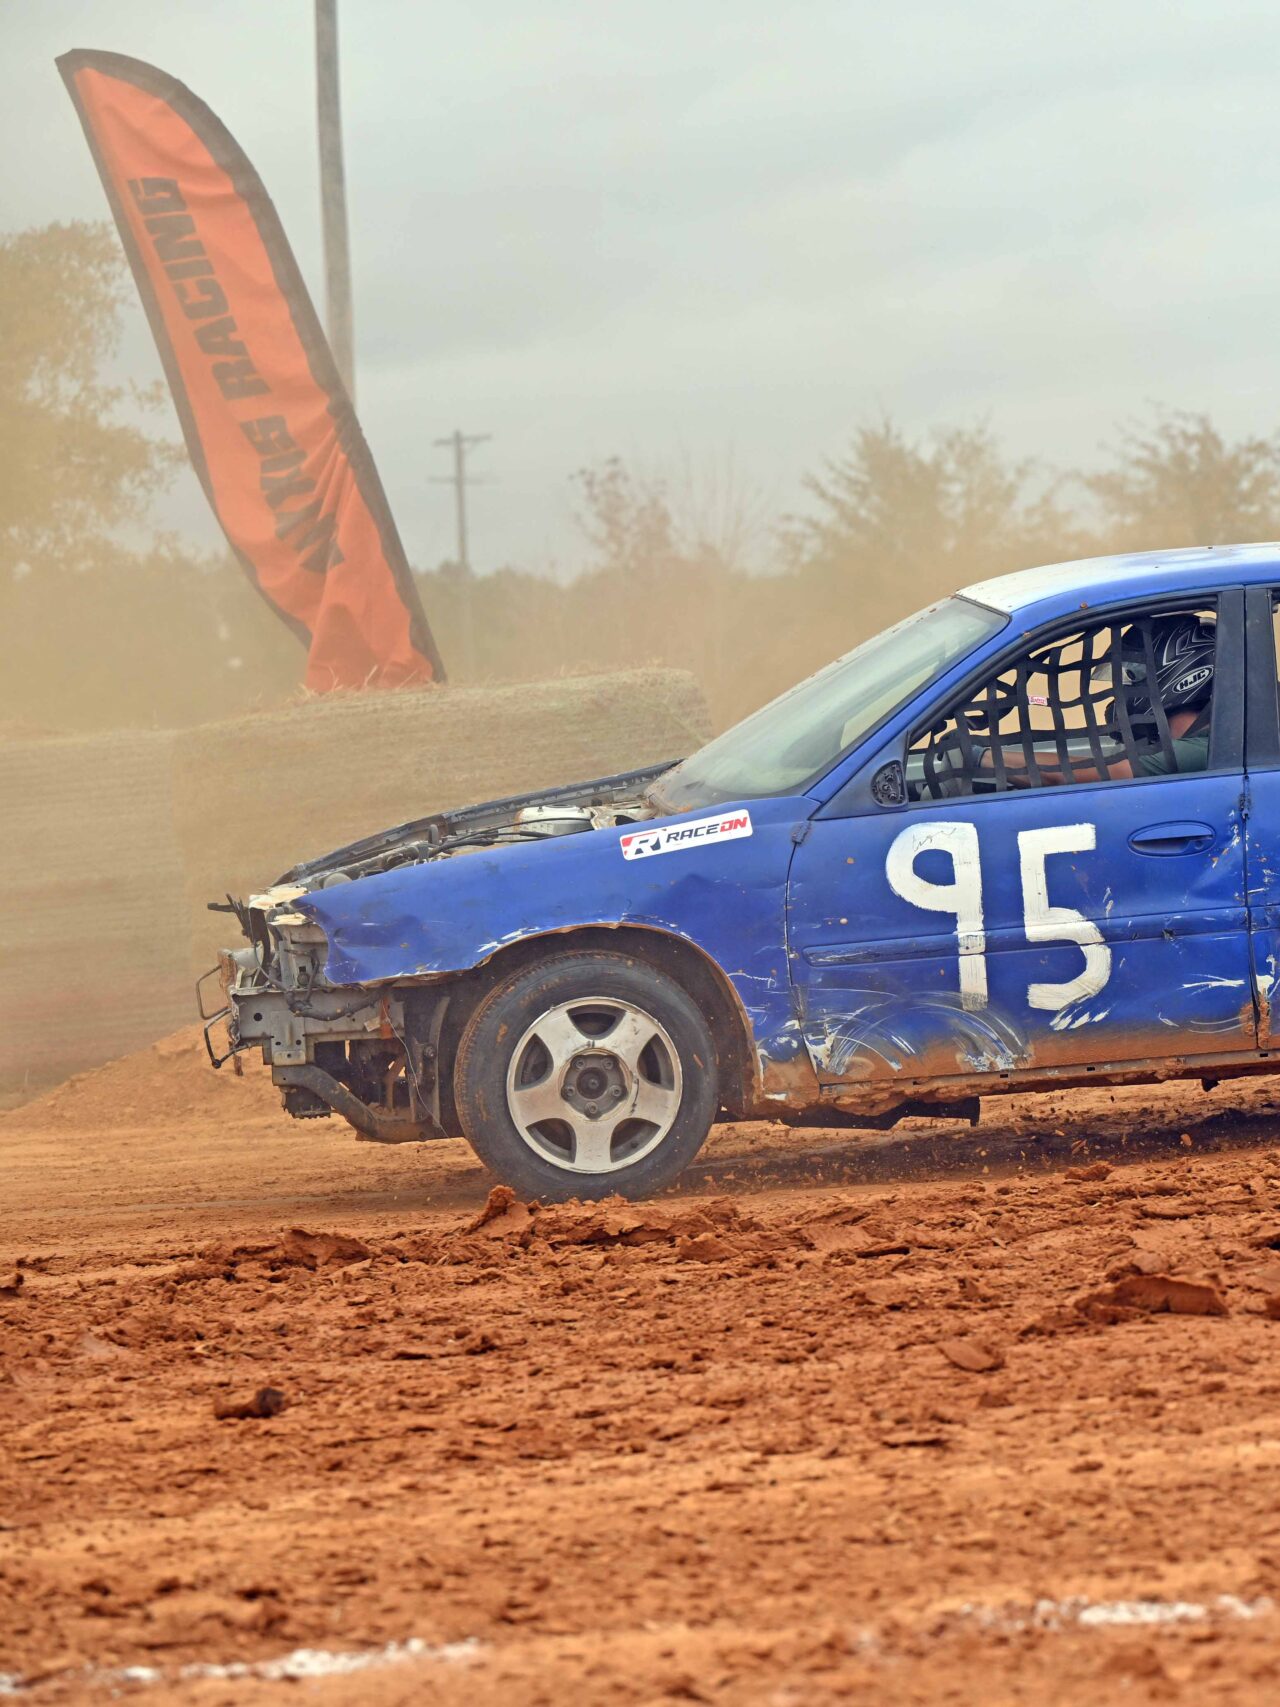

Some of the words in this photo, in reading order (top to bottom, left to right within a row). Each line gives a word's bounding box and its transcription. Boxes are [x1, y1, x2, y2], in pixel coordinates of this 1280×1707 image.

[127, 176, 273, 401] RACING
[1179, 669, 1207, 691] HJC
[665, 816, 748, 844] RACEON
[885, 821, 1112, 1011] 95
